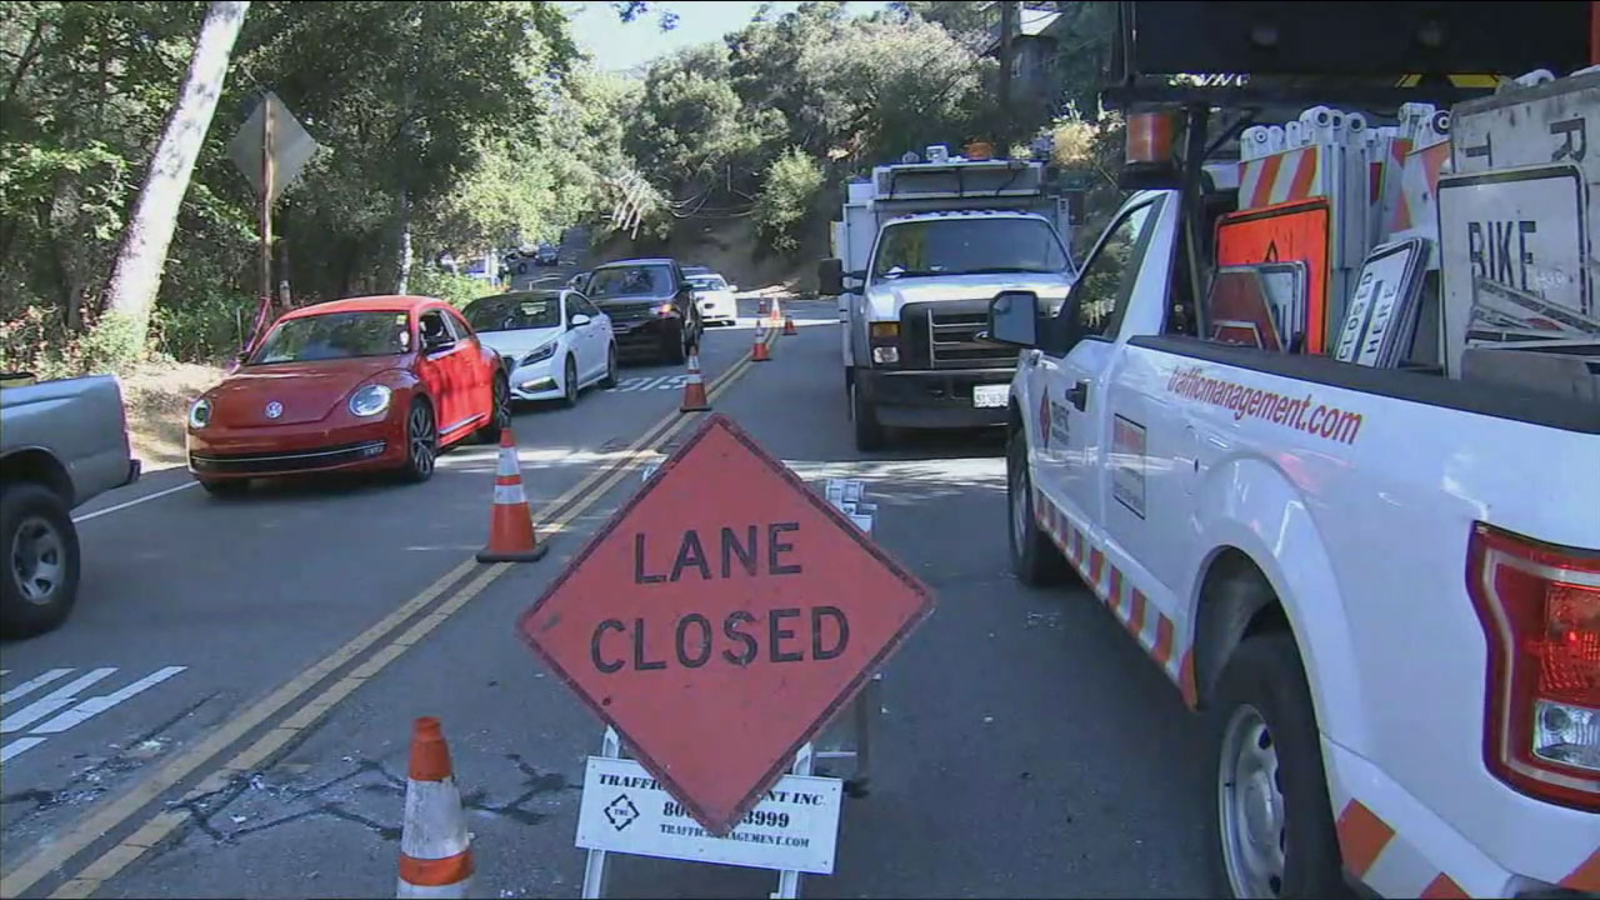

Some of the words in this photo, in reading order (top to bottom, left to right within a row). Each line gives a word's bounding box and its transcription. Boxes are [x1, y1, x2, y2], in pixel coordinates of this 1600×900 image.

[1467, 220, 1539, 296] BIKE
[1339, 272, 1373, 359] CLOSED
[1366, 284, 1397, 353] HERE
[1167, 366, 1362, 445] trafficmanagement.com
[635, 522, 803, 584] LANE
[590, 606, 850, 674] CLOSED
